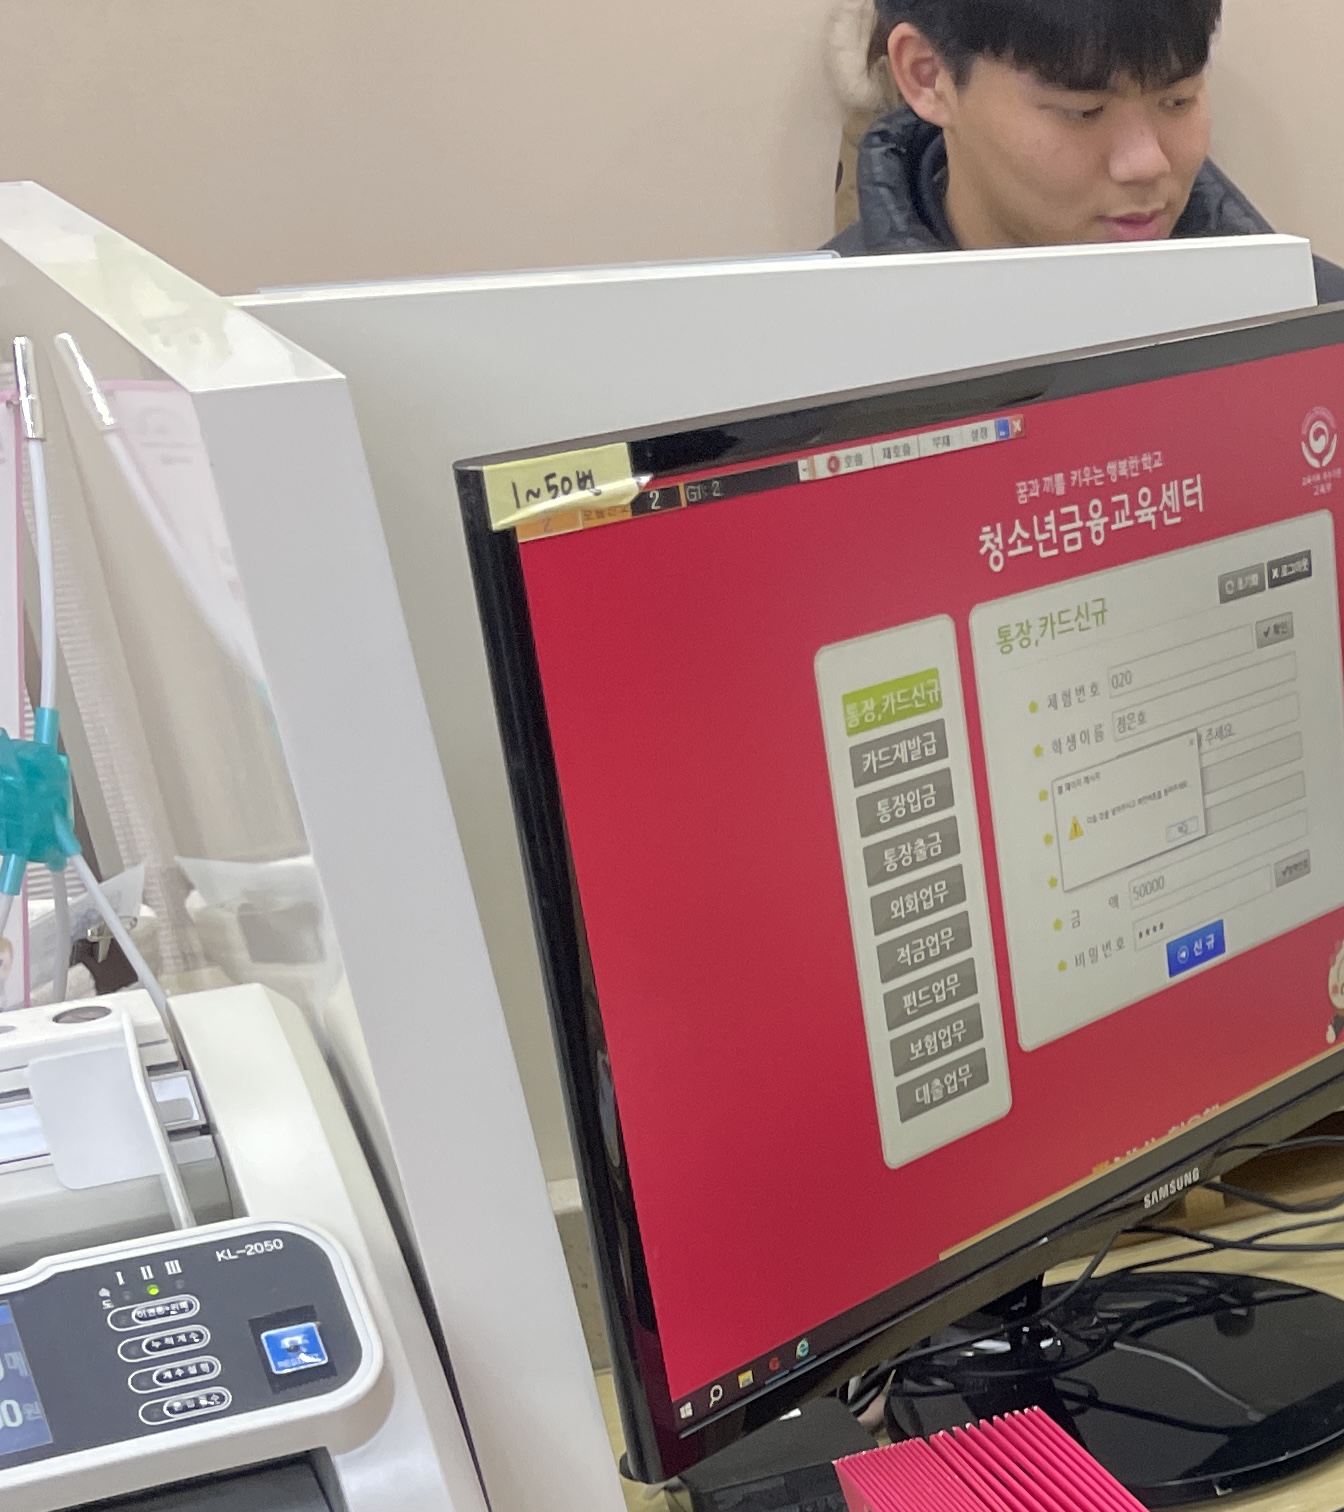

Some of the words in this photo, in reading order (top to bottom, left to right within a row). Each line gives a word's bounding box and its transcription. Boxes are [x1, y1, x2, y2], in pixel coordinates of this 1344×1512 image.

[1070, 465, 1105, 488] 키우는
[650, 490, 661, 510] 2
[978, 472, 1204, 573] 청소년금융교육센터
[996, 597, 1109, 655] 통장,카드신규
[1111, 670, 1133, 689] 020
[845, 677, 940, 728] 통장,카드신규
[861, 731, 937, 774] 카드재발급
[876, 783, 937, 824] 통장입금
[883, 831, 943, 873] 통장출금
[890, 879, 950, 920] 외화업무
[1132, 875, 1165, 901] 50000
[1070, 909, 1082, 930] 금
[897, 926, 955, 966] 적금업무
[1193, 933, 1216, 957] 신규
[902, 973, 962, 1016] 펀드업무
[910, 1019, 967, 1062] 보험업무
[915, 1063, 973, 1106] 대출업무
[1143, 1166, 1201, 1209] SAMSUNG
[215, 1238, 284, 1262] KL-2050
